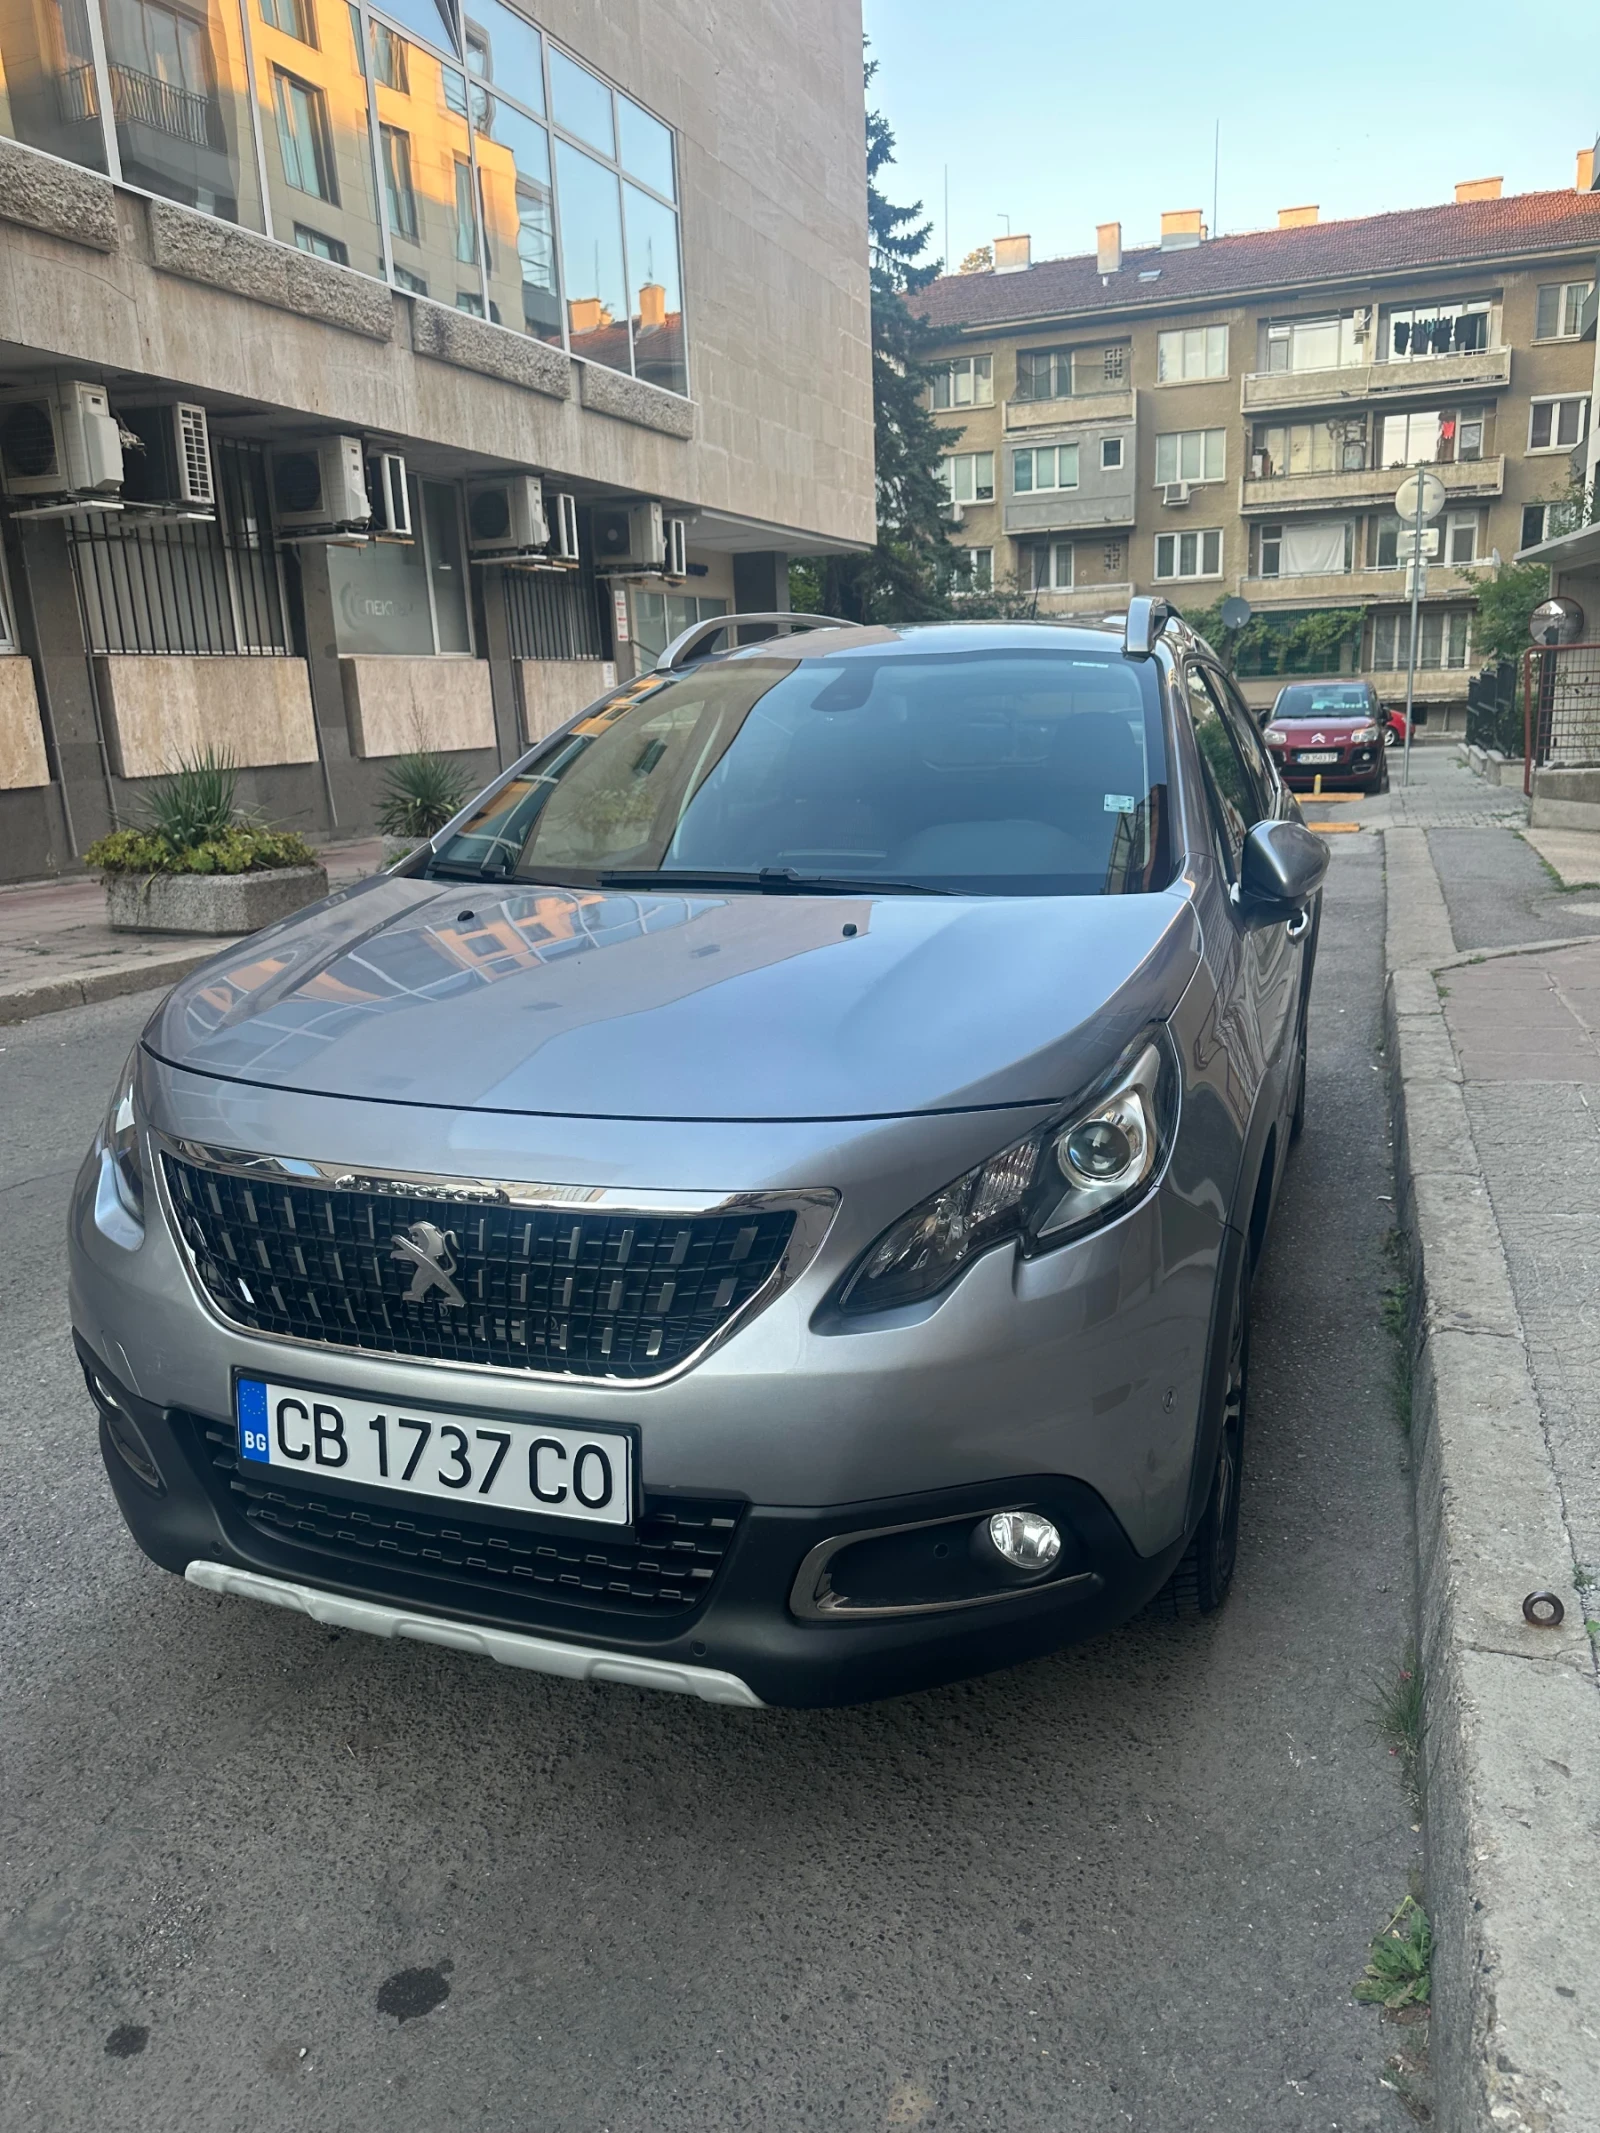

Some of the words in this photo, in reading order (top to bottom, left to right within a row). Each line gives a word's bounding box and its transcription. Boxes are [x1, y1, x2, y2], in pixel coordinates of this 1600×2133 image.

[244, 1429, 267, 1452] BG
[276, 1397, 349, 1468] CB
[368, 1413, 512, 1495] 1737
[528, 1437, 613, 1510] CO
